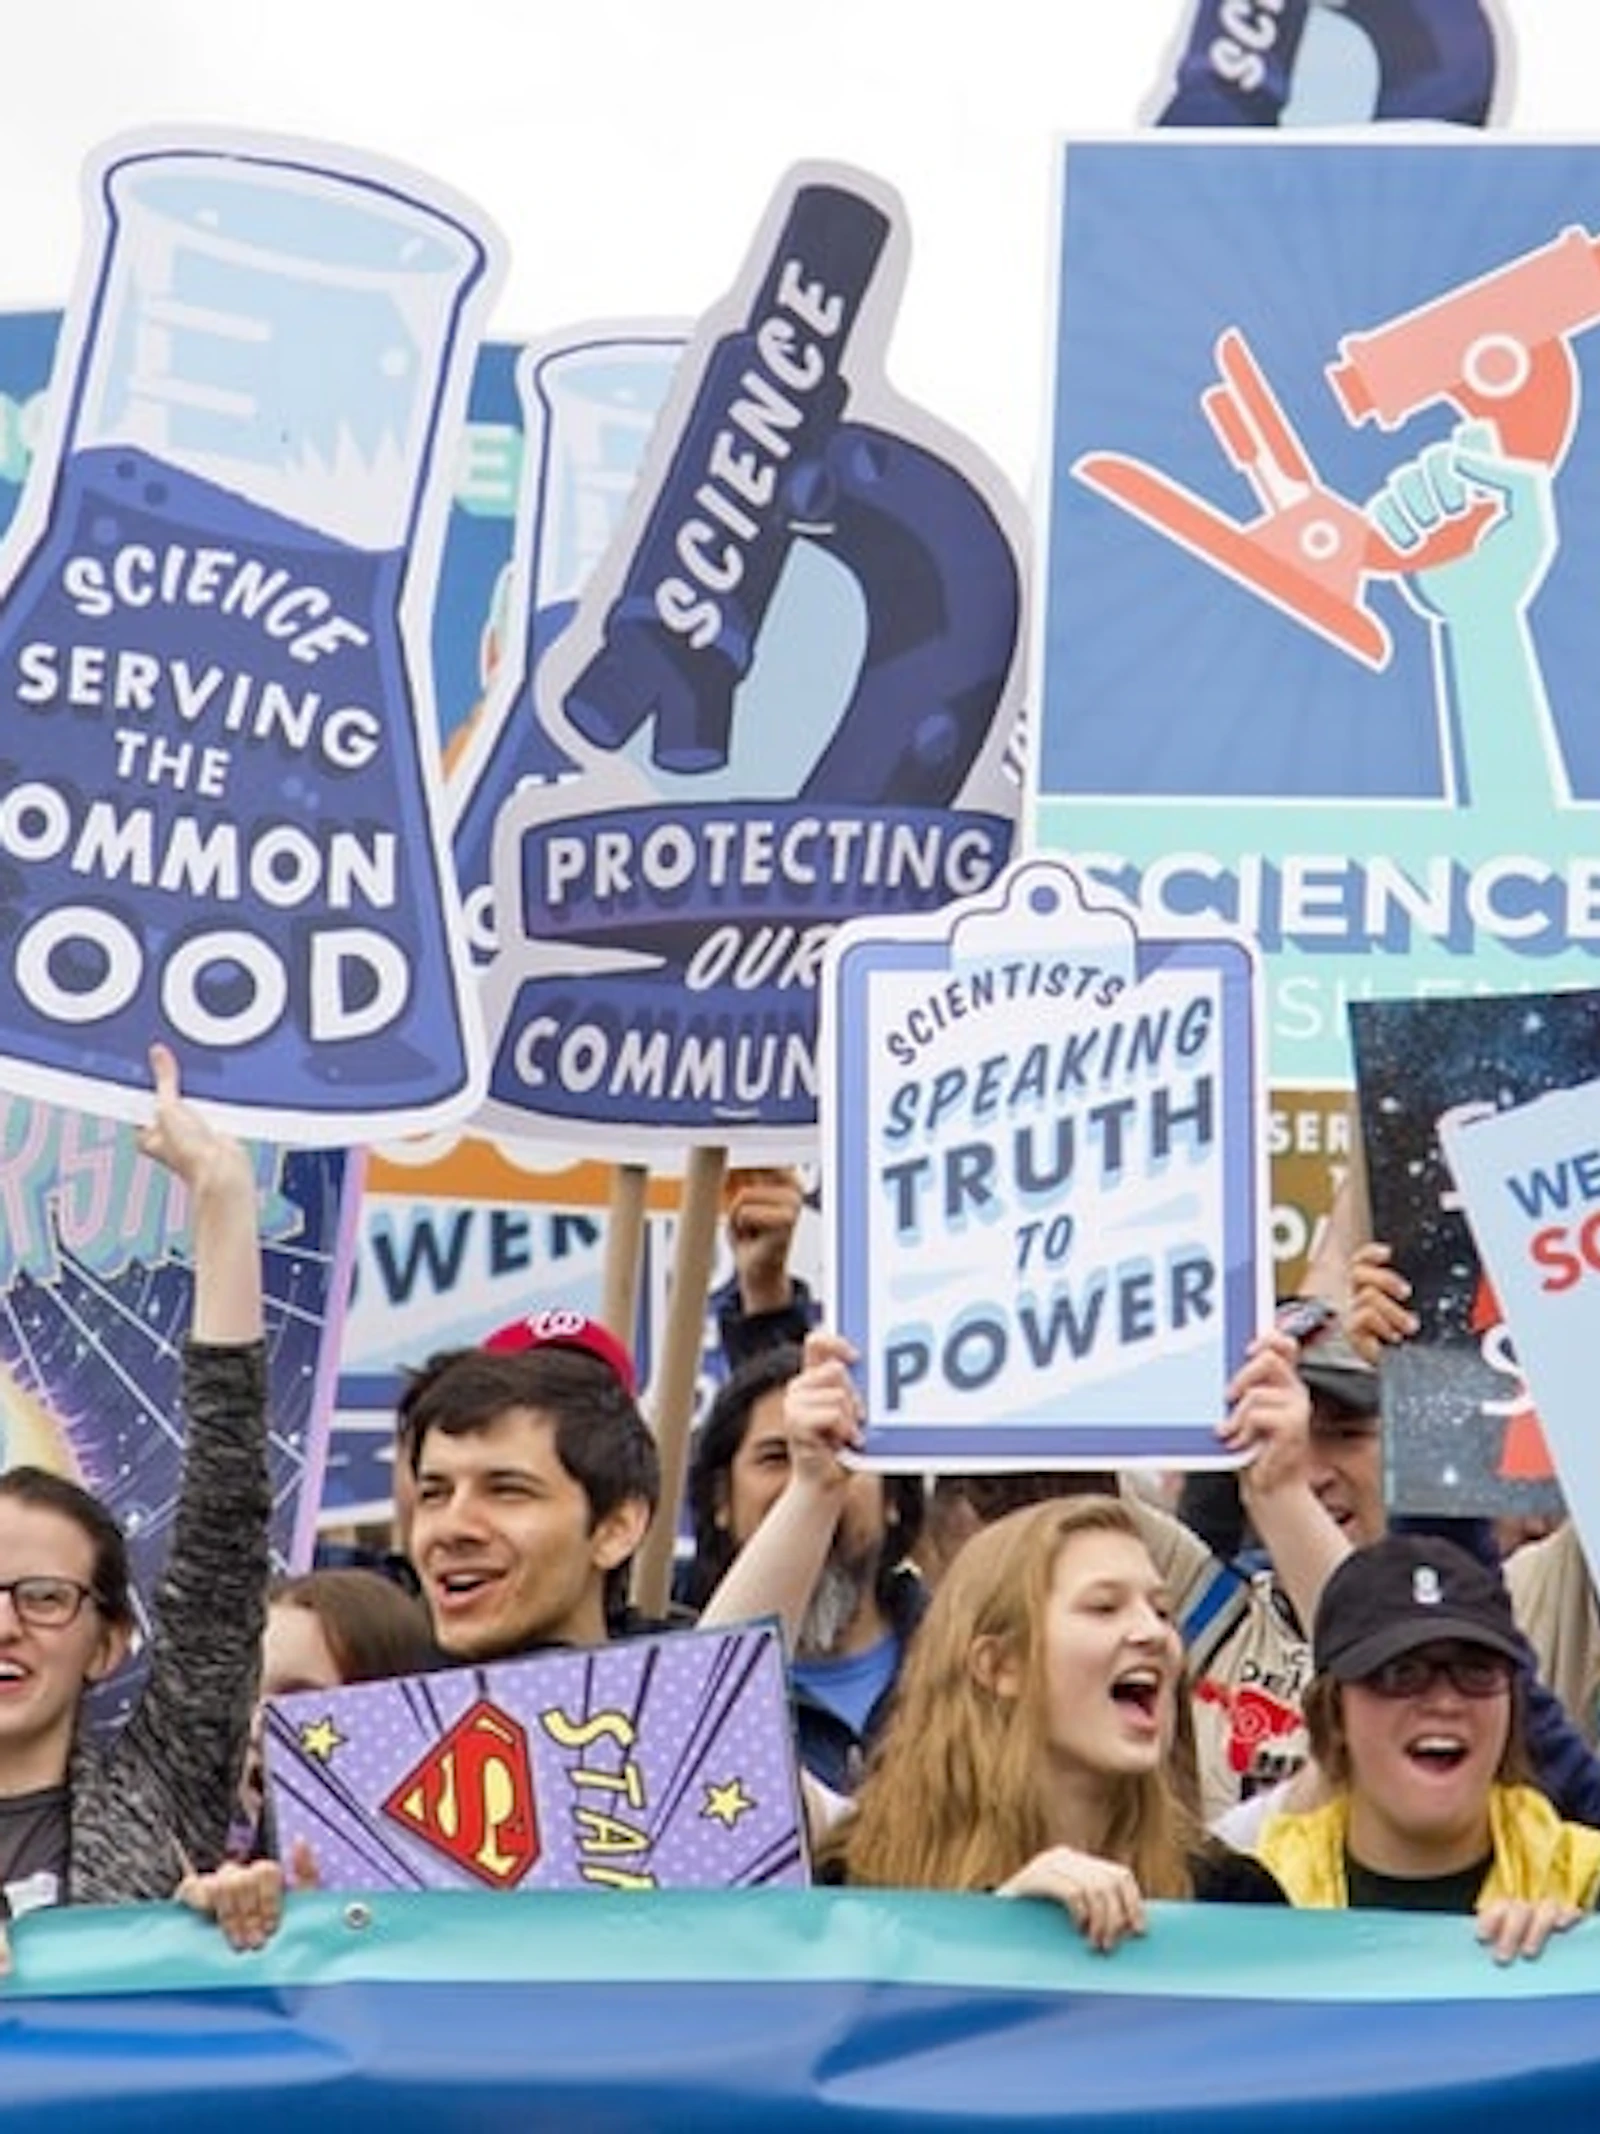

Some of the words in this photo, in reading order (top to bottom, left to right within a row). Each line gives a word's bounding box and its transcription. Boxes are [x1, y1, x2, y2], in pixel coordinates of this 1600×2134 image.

[1210, 0, 1284, 91] SC
[655, 260, 843, 650] SCIENCE
[64, 544, 370, 665] SCIENCE
[17, 642, 379, 768] SERVING
[115, 729, 231, 796] THE
[546, 816, 993, 903] PROTECTING
[685, 924, 836, 991] OUR
[886, 961, 1125, 1066] SCIENTISTS
[882, 995, 1213, 1141] SPEAKING
[881, 1075, 1213, 1232] TRUTH
[1014, 1212, 1075, 1271] TO
[884, 1256, 1217, 1413] POWER
